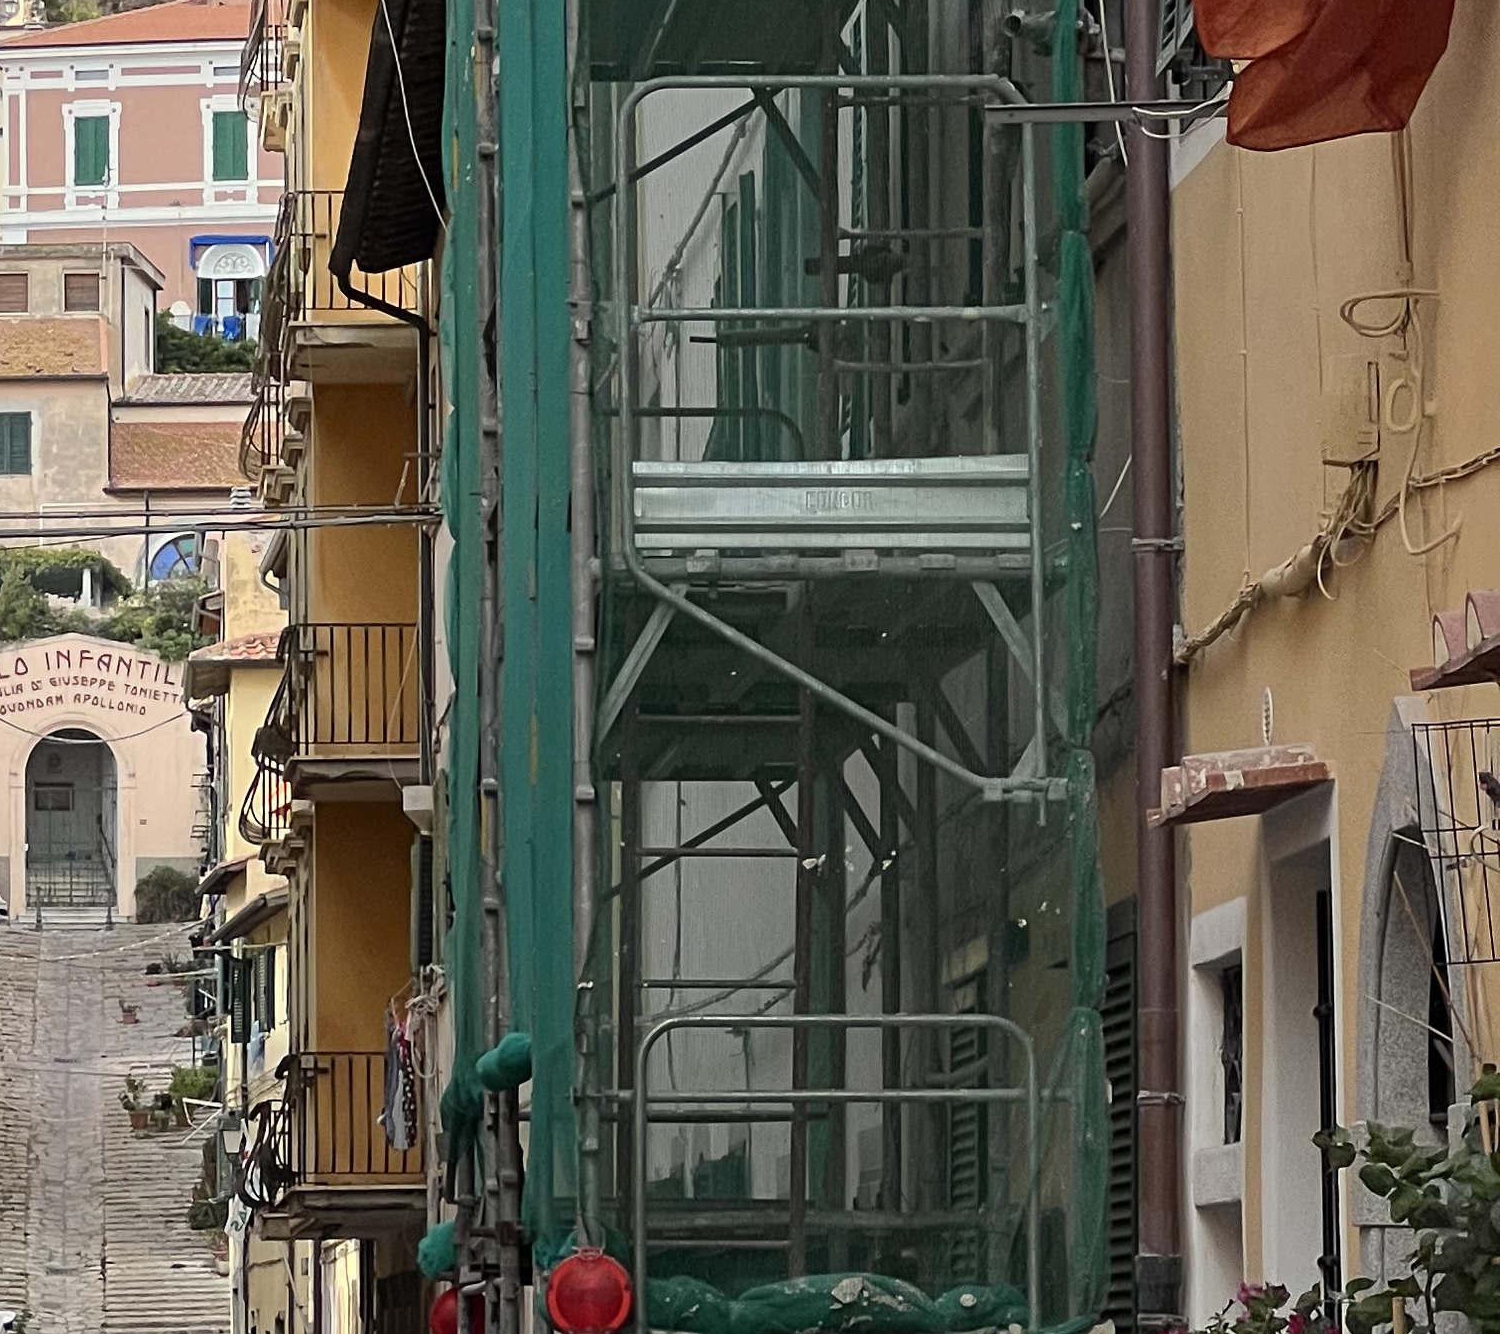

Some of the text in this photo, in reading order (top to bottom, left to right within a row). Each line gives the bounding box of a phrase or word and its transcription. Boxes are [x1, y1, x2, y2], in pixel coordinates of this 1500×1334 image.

[45, 649, 176, 686] INFANTIL
[49, 675, 116, 692] GIUSEPPE
[124, 683, 182, 705] TONIETT
[73, 693, 147, 716] APOLLONIO
